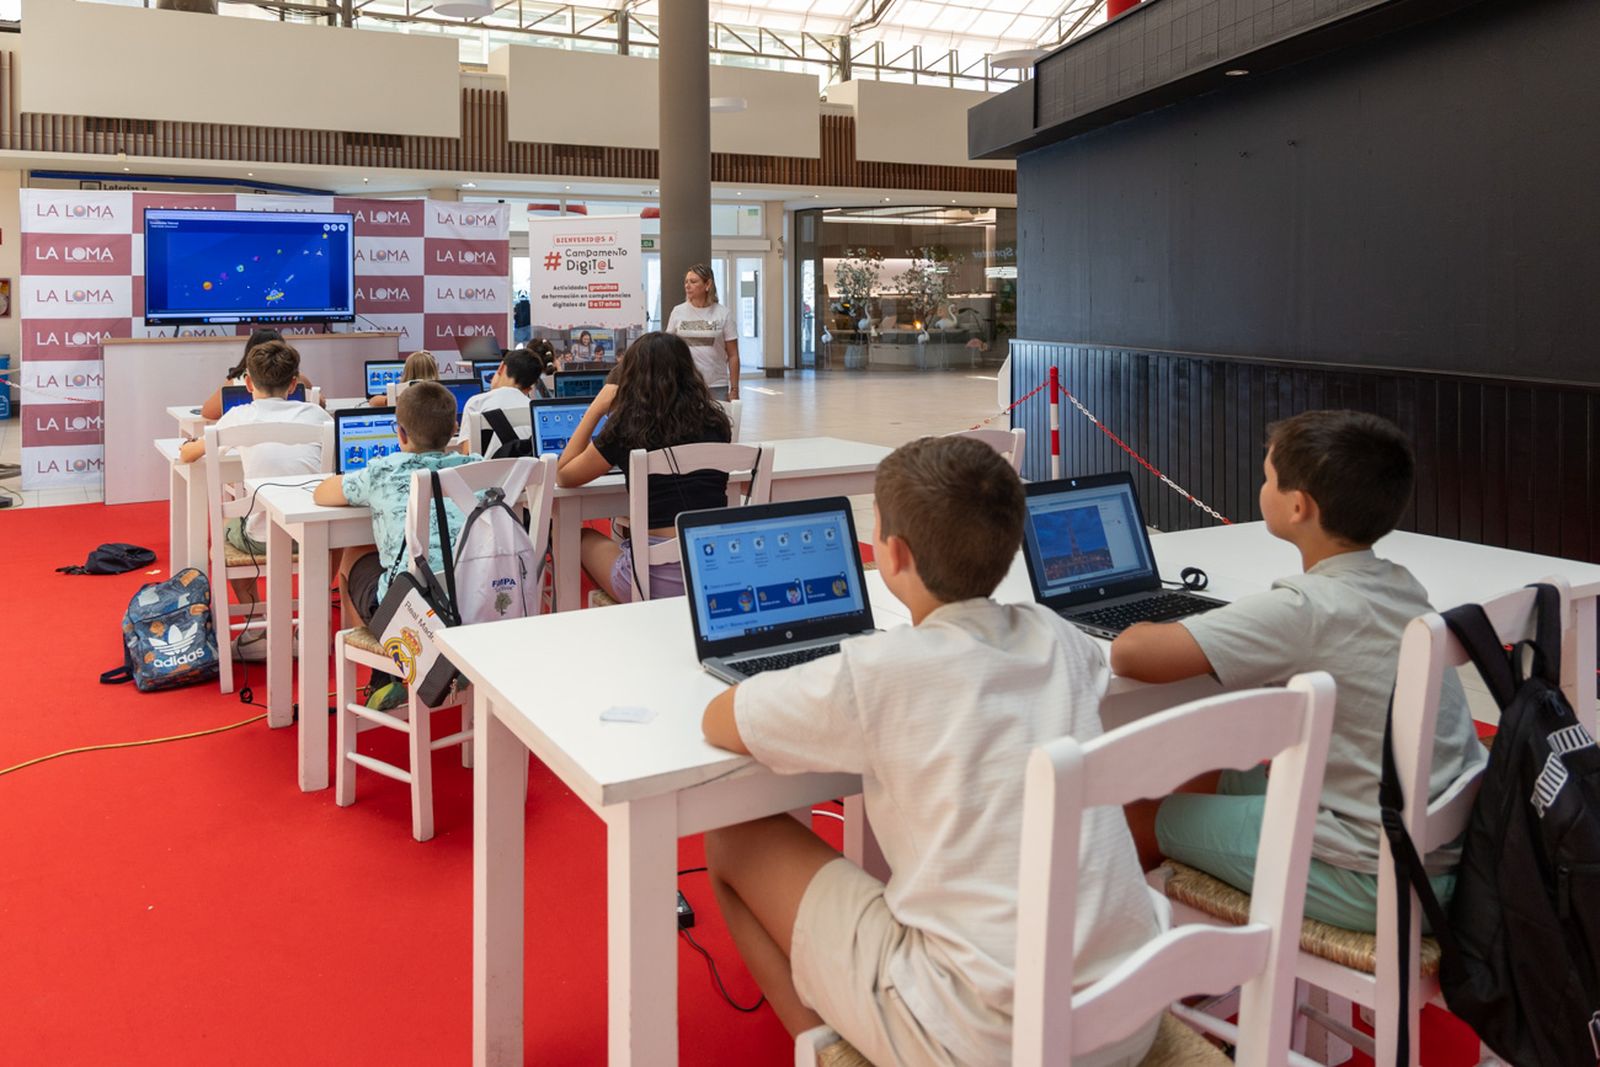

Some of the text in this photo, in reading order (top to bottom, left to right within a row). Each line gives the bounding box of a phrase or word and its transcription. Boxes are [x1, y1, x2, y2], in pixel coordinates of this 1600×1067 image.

[37, 204, 114, 218] LA LOMA
[354, 210, 410, 224] A LOMA
[437, 213, 497, 226] LA LOMA
[36, 246, 114, 261] LA LOMA
[354, 250, 410, 262] A LOMA
[437, 250, 496, 263] LA LOMA
[37, 289, 114, 303] LA LOMA
[354, 288, 410, 300] A LOMA
[437, 288, 496, 300] LA LOMA
[436, 325, 496, 337] LA LOMA
[37, 332, 59, 345] LA
[37, 375, 59, 388] LA
[37, 417, 59, 431] LA
[38, 460, 60, 474] LA
[404, 601, 435, 643] Real Madr
[153, 647, 205, 668] adidas
